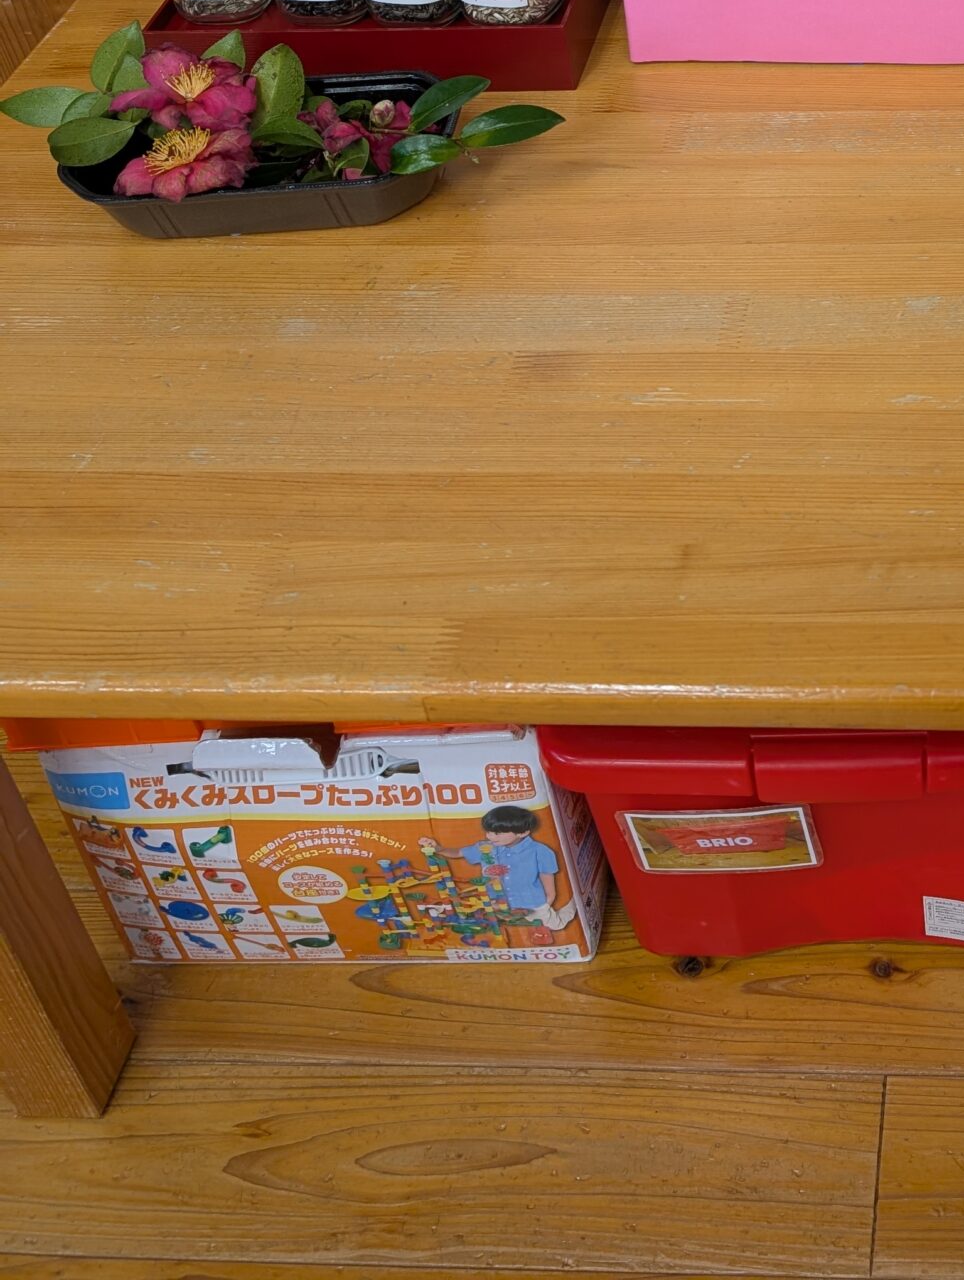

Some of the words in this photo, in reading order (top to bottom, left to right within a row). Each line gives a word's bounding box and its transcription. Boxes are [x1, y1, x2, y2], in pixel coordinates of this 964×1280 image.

[487, 767, 529, 779] 対象年齢
[129, 776, 164, 788] NEW
[490, 779, 531, 793] 3才以上
[56, 784, 119, 798] KUMON
[133, 782, 483, 810] くみくみスロープたっぷり100
[696, 836, 754, 848] BRIO
[455, 950, 527, 961] KUMON
[533, 949, 571, 960] TOY
